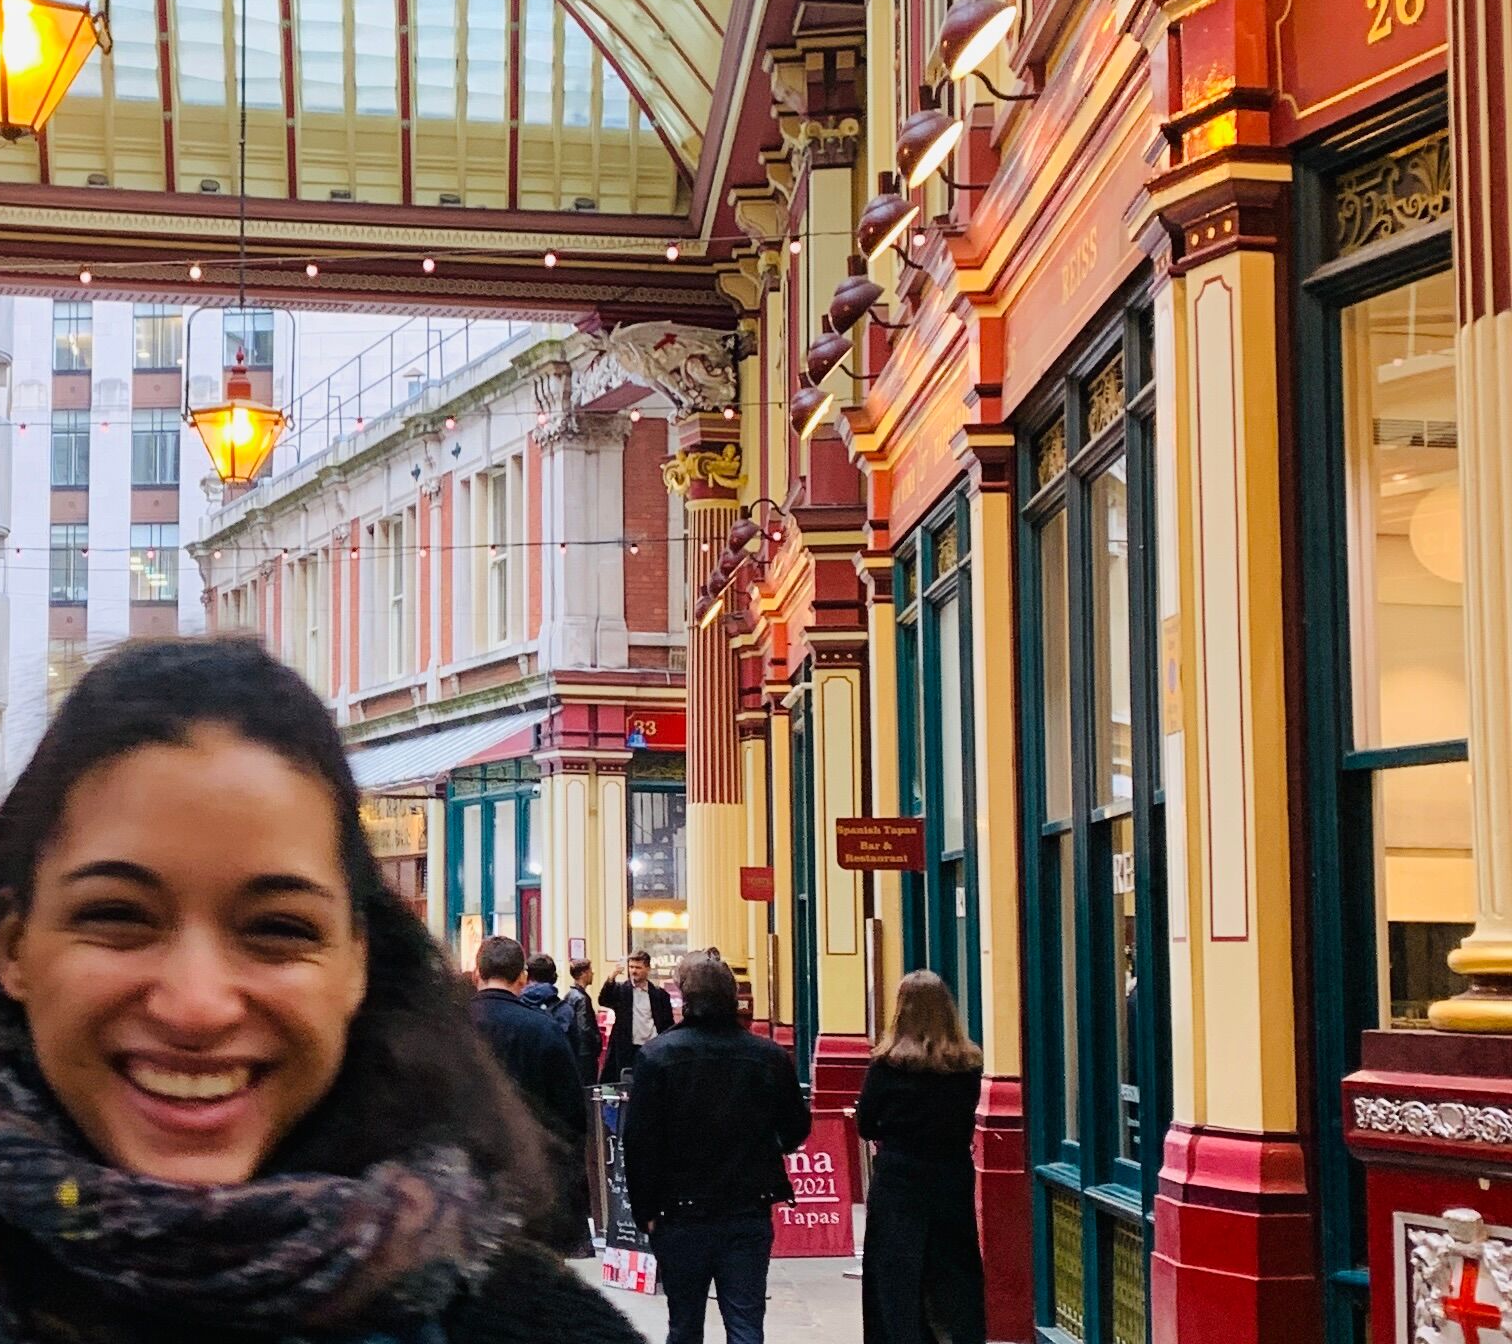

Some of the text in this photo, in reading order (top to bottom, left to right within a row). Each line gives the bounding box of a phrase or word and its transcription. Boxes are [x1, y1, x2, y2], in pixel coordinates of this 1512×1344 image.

[633, 719, 657, 736] 33
[837, 825, 918, 836] Spanish Tapas
[860, 841, 893, 851] Bar &
[845, 853, 908, 863] Restaurant
[793, 1177, 836, 1195] 2021
[778, 1206, 840, 1229] Tapas
